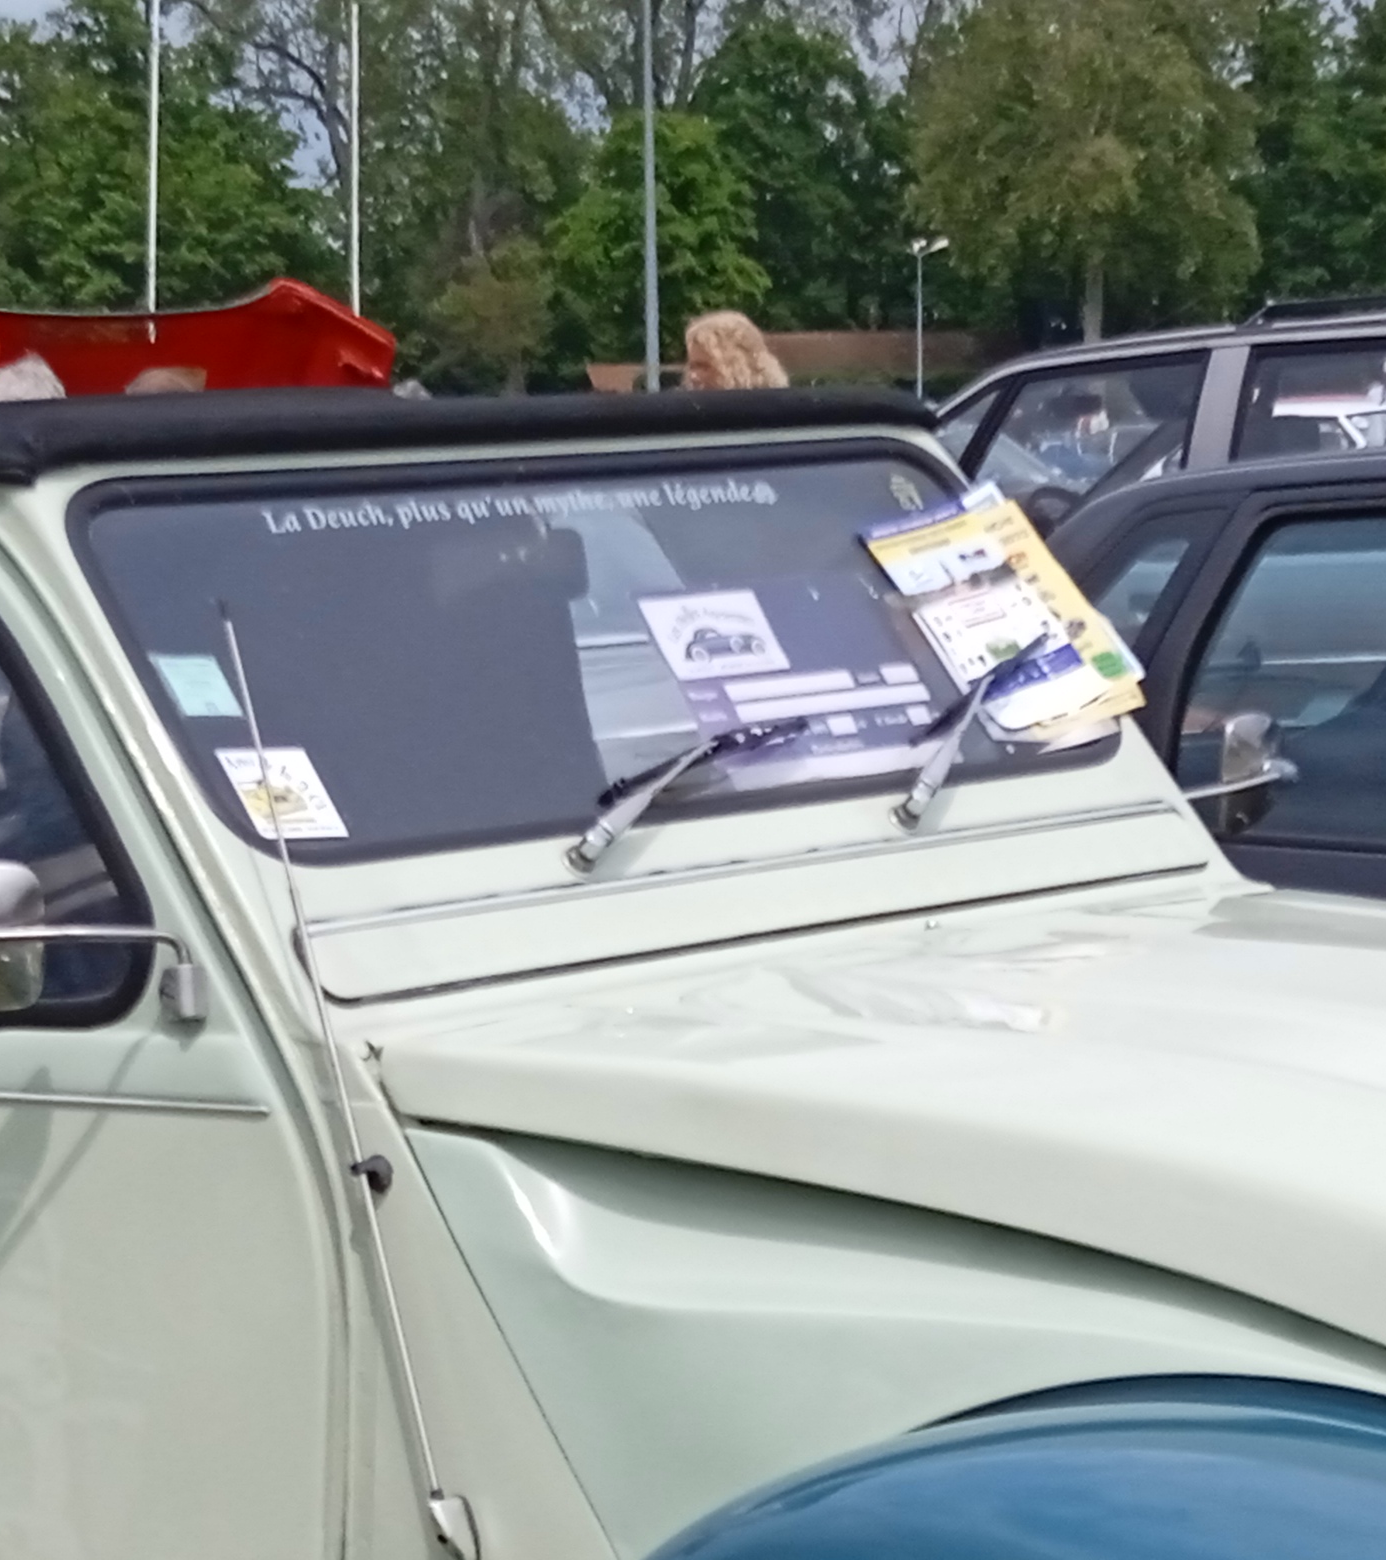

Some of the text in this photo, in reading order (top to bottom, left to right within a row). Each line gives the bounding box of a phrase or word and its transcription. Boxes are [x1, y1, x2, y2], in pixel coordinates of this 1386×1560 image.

[262, 509, 302, 535] La
[302, 501, 395, 531] Deuch,
[396, 499, 452, 530] plus
[456, 495, 530, 525] qu'un
[662, 478, 750, 511] légende
